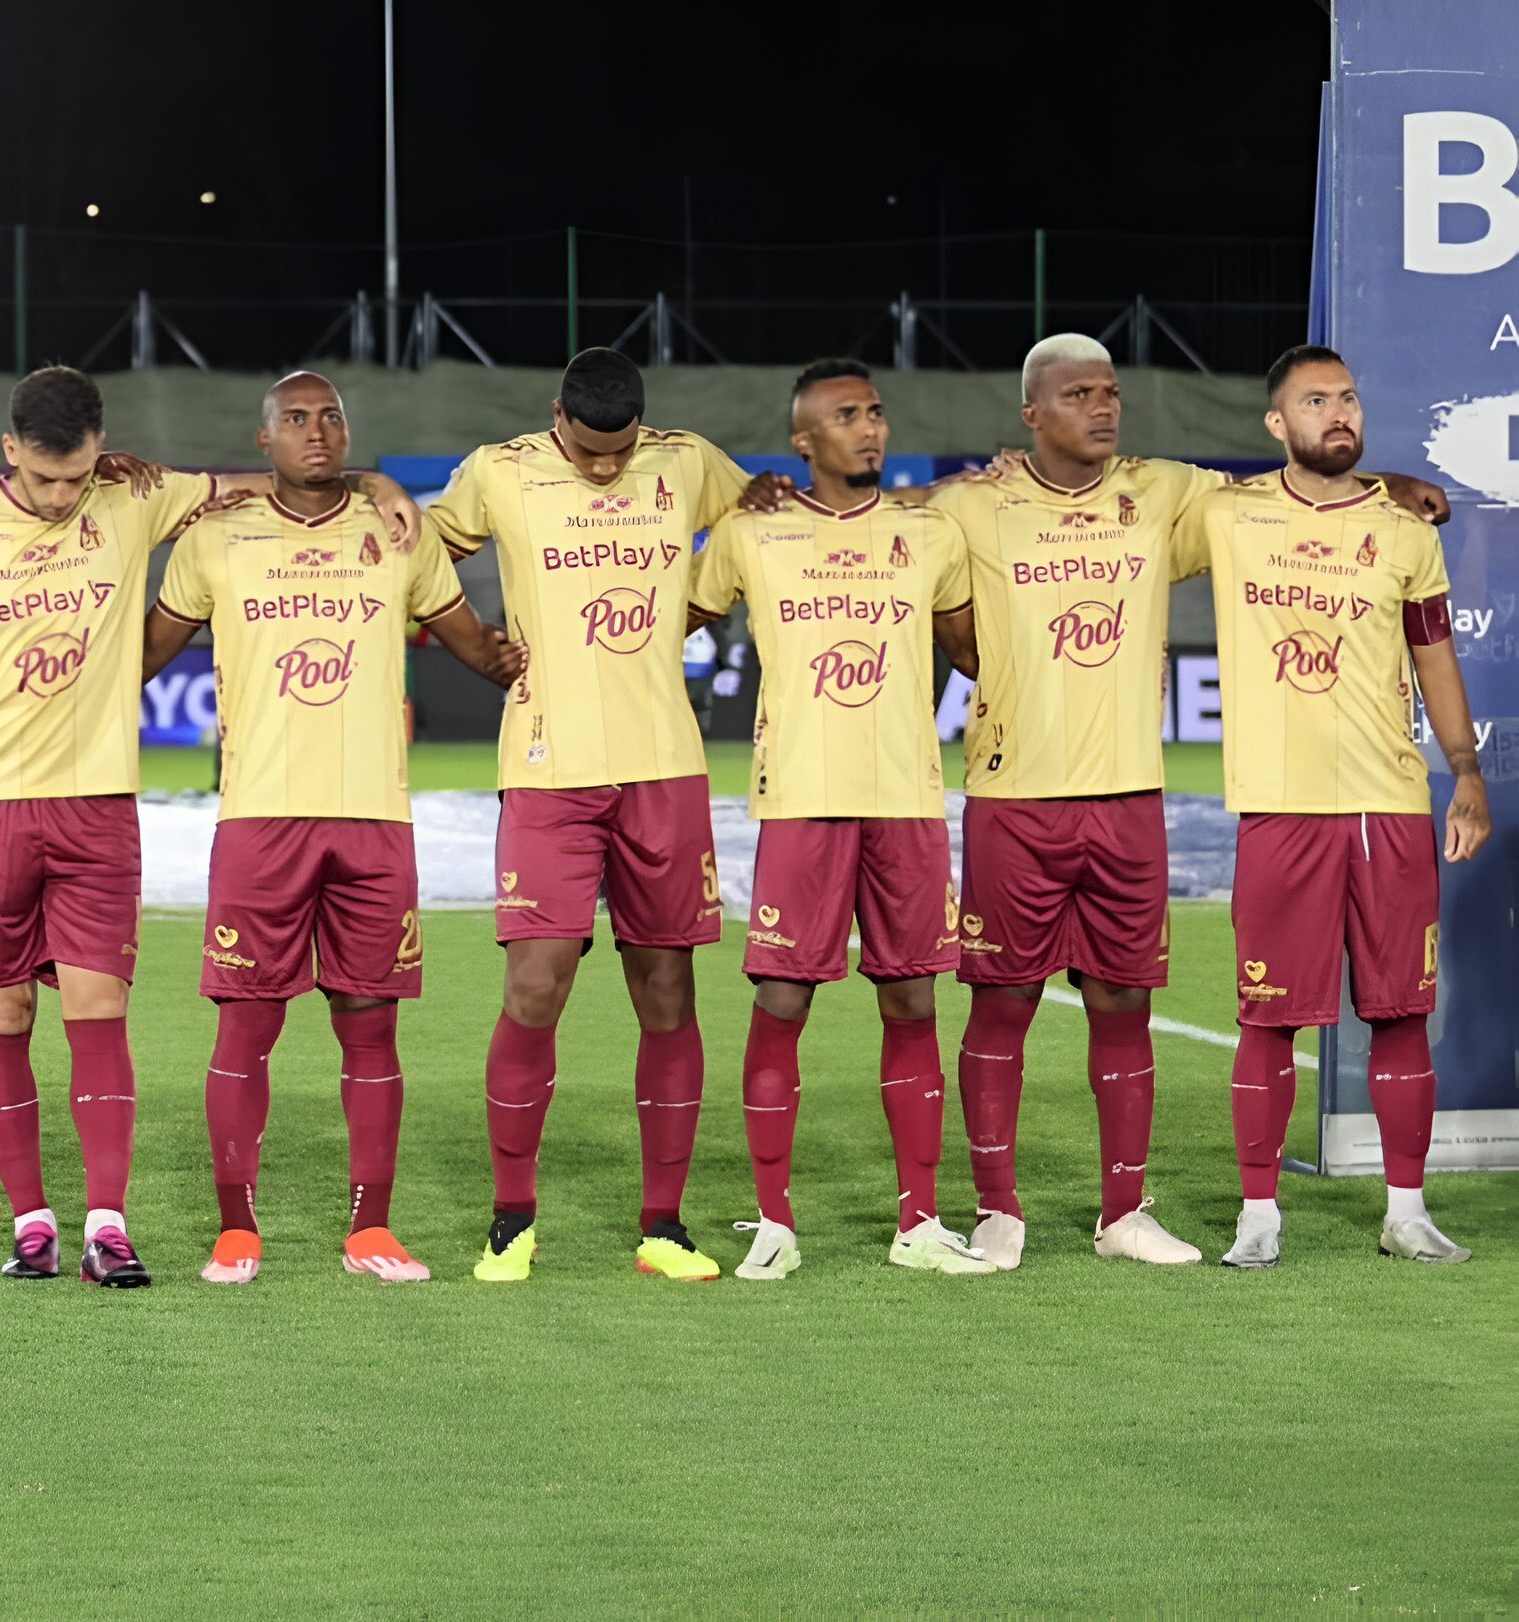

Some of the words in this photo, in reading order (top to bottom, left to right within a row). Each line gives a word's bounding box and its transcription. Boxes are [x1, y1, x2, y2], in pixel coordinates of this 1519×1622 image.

[543, 540, 655, 571] BetPlay
[1013, 555, 1121, 585] BetPlay
[244, 593, 353, 622] BetPlay
[580, 586, 657, 646] Pool
[779, 593, 886, 625] BetPlay
[1245, 582, 1345, 618] BetPlay
[1048, 598, 1126, 660] Pool
[275, 639, 356, 697] Pool
[809, 641, 888, 699] Pool
[1271, 635, 1344, 683] Pool
